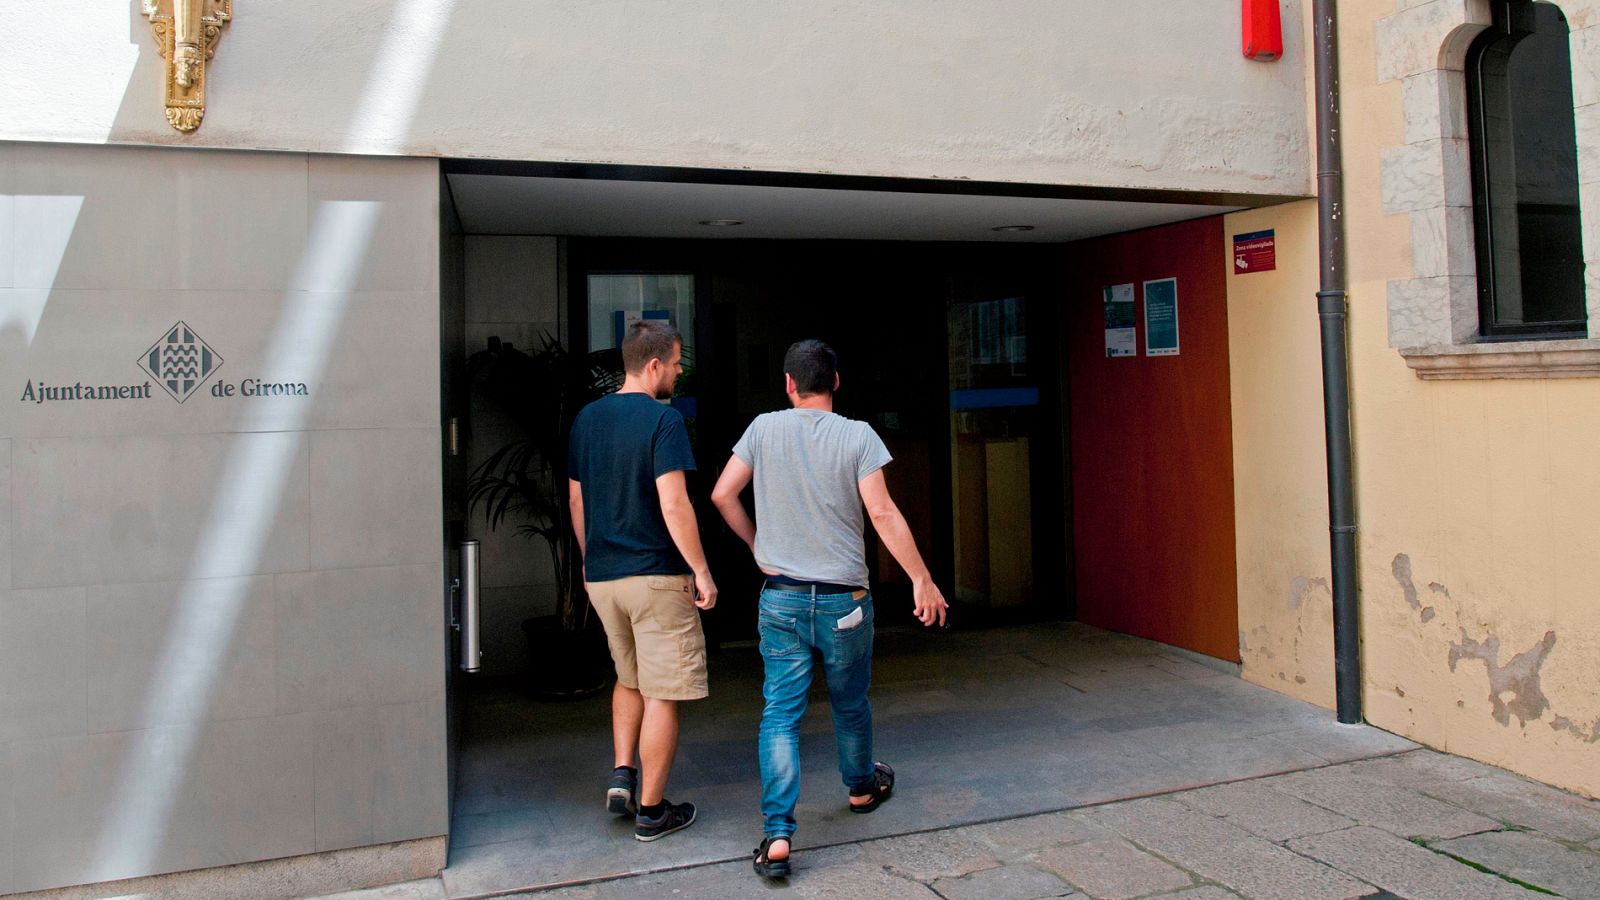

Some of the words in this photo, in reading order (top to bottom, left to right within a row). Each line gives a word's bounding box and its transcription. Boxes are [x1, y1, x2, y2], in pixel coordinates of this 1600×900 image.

[20, 378, 152, 404] Ajuntament
[211, 379, 235, 398] de
[240, 378, 309, 398] Girona
